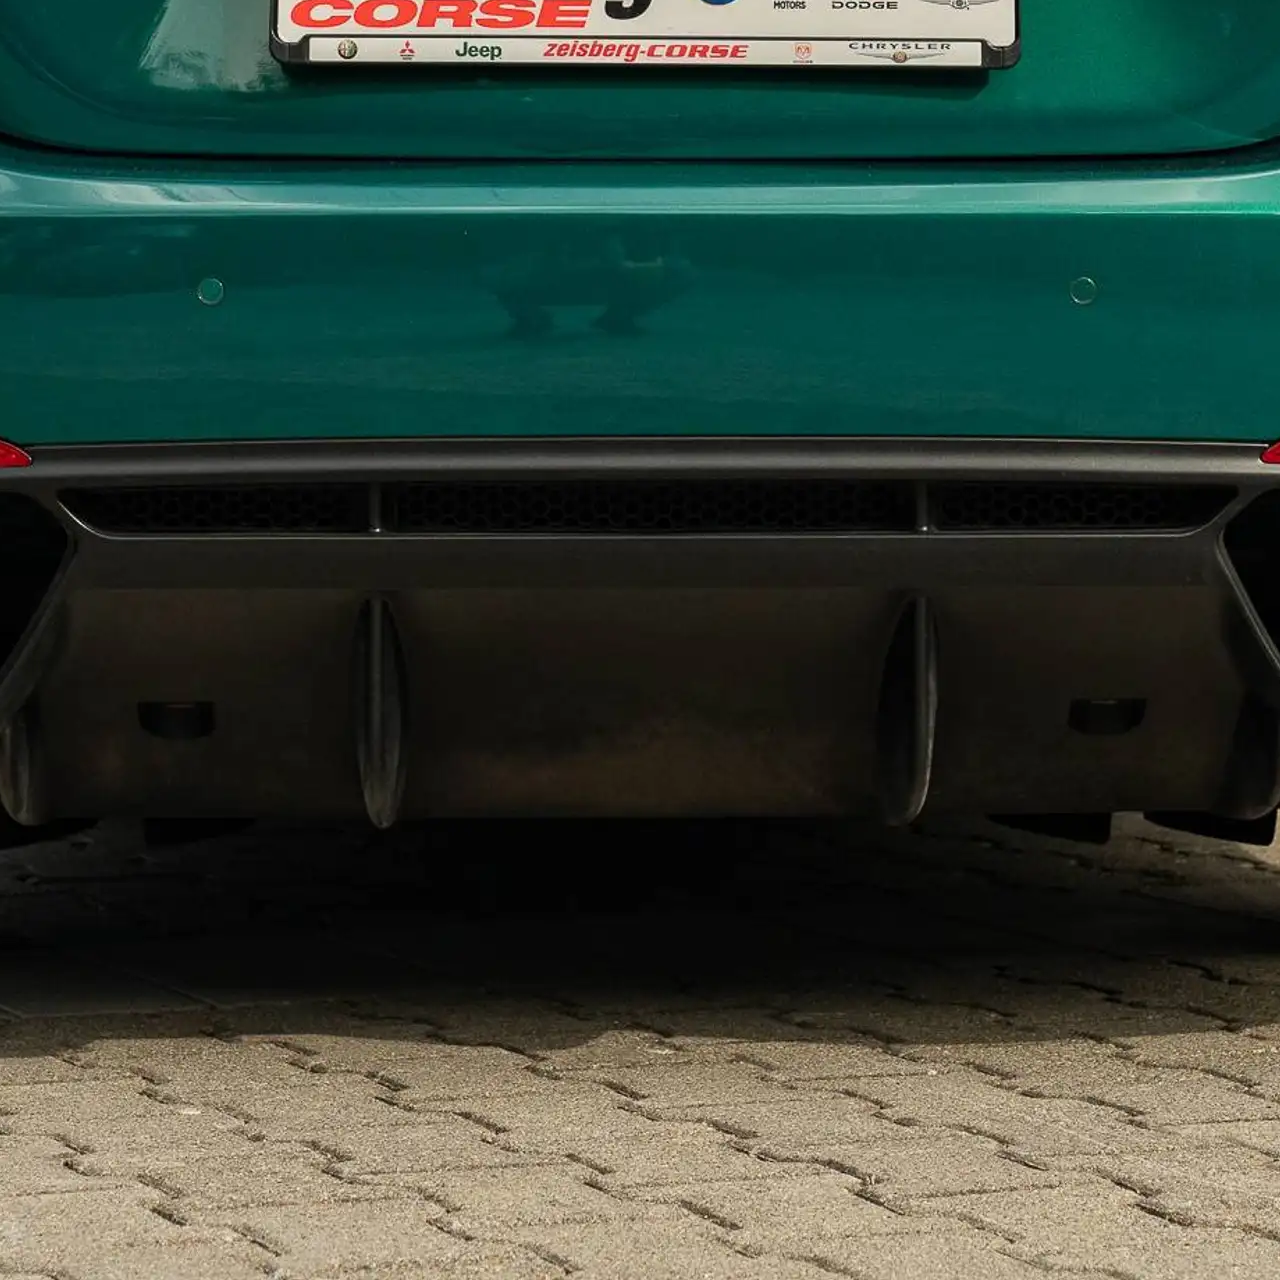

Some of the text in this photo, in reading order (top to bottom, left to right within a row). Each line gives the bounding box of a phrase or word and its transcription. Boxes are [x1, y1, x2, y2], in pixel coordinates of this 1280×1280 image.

[773, 0, 807, 10] MOTORS
[831, 0, 899, 10] DODGE
[454, 41, 503, 61] Jeep
[848, 42, 952, 50] CHRYSLER
